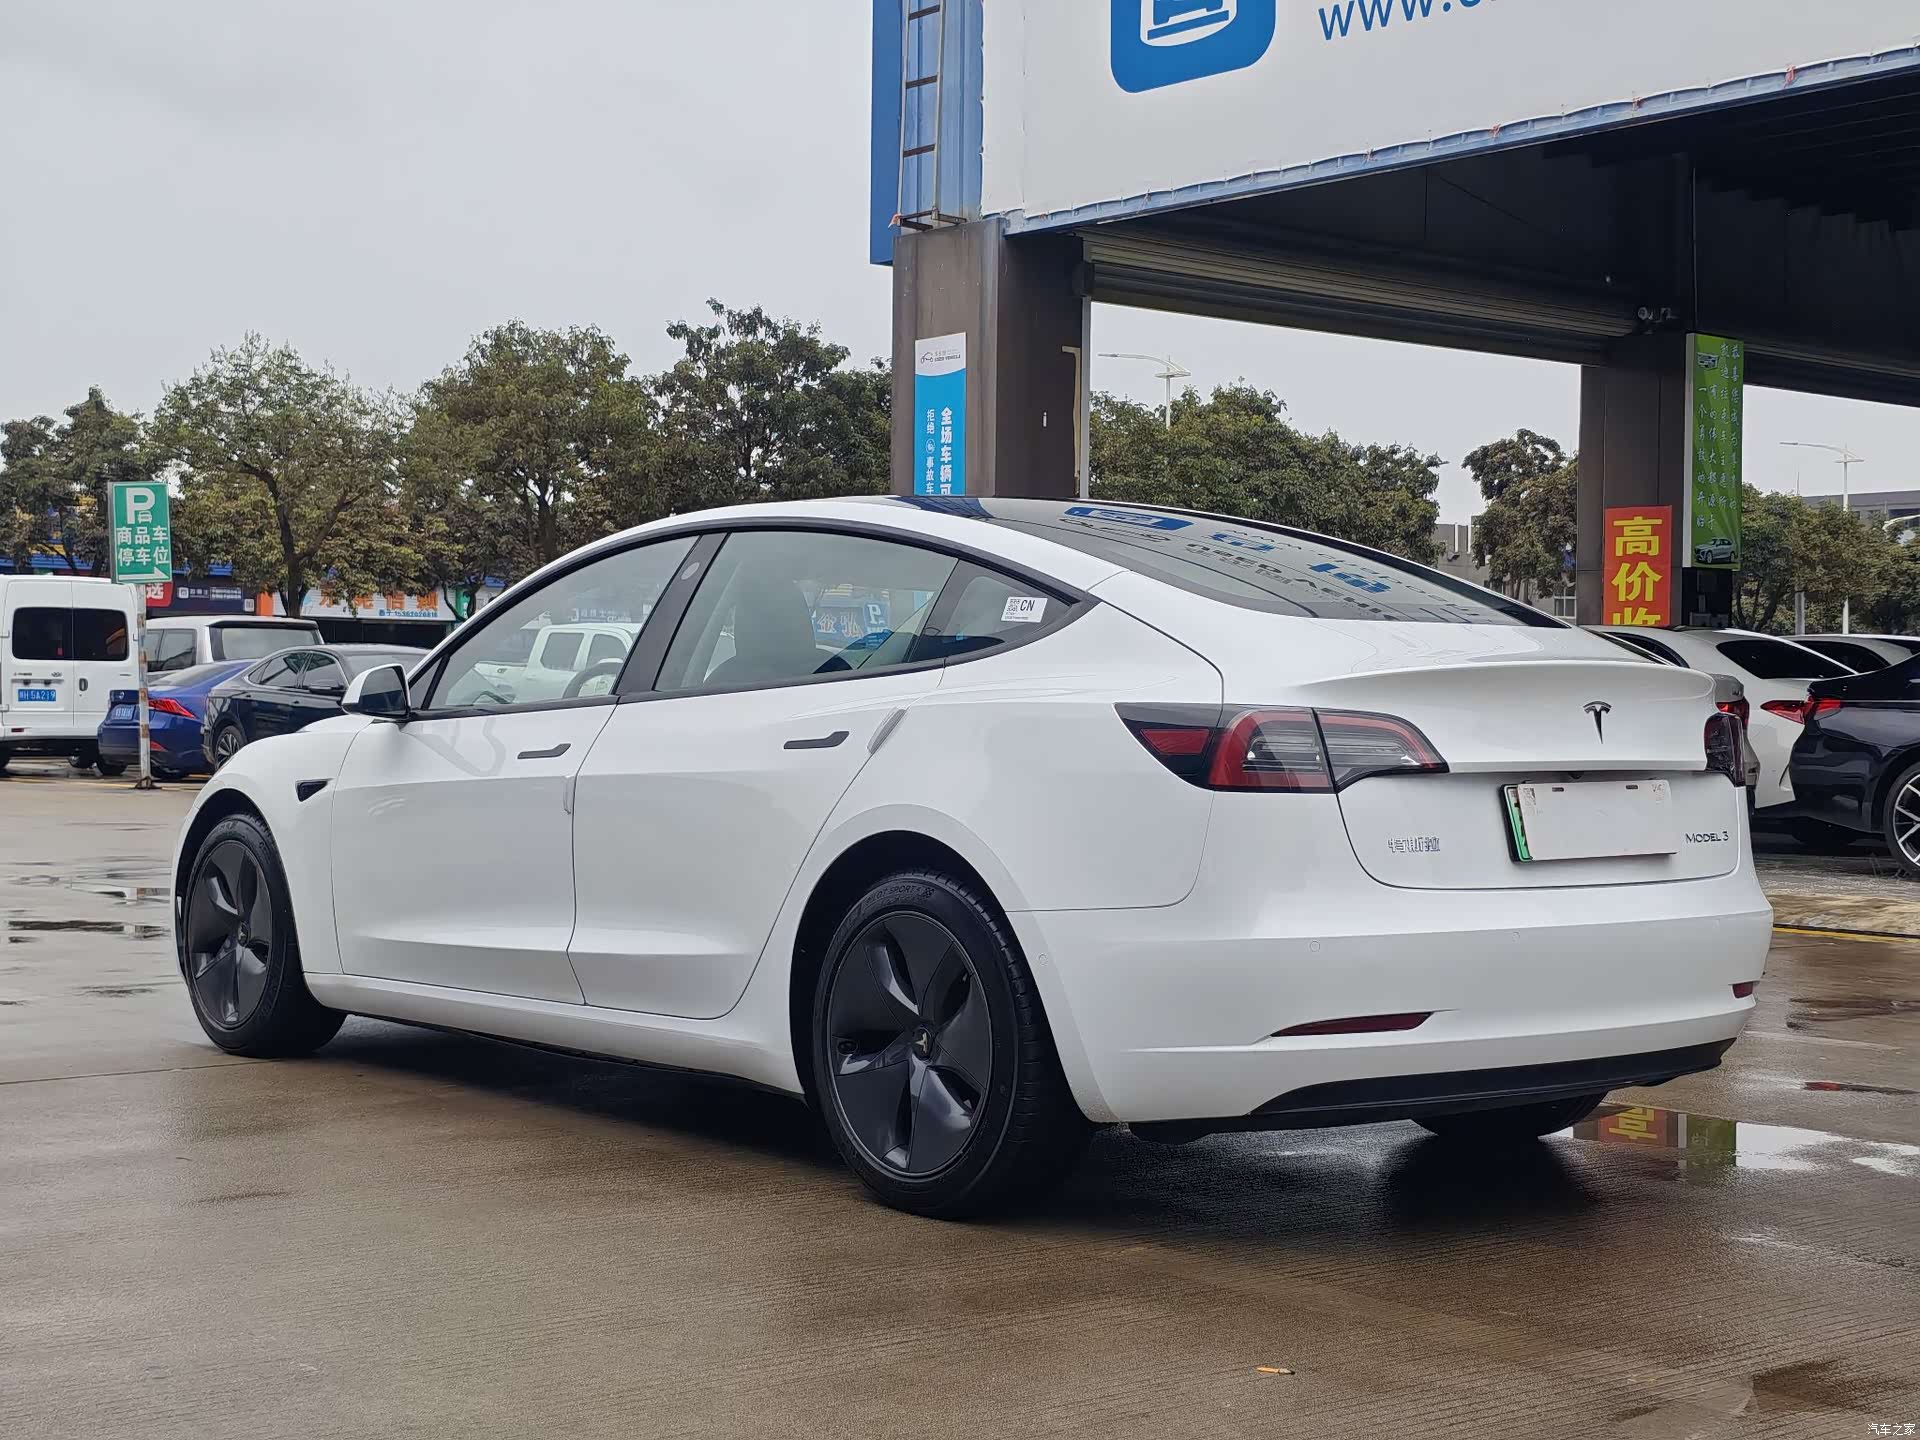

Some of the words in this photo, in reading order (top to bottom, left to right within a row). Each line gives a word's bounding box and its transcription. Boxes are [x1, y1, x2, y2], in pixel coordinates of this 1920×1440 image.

[1318, 0, 1481, 40] www.
[126, 487, 156, 525] P
[116, 525, 169, 545] 商品车
[117, 546, 169, 567] 停车位
[1020, 599, 1036, 612] CN
[1685, 832, 1722, 843] MODEL
[1721, 830, 1729, 842] 3
